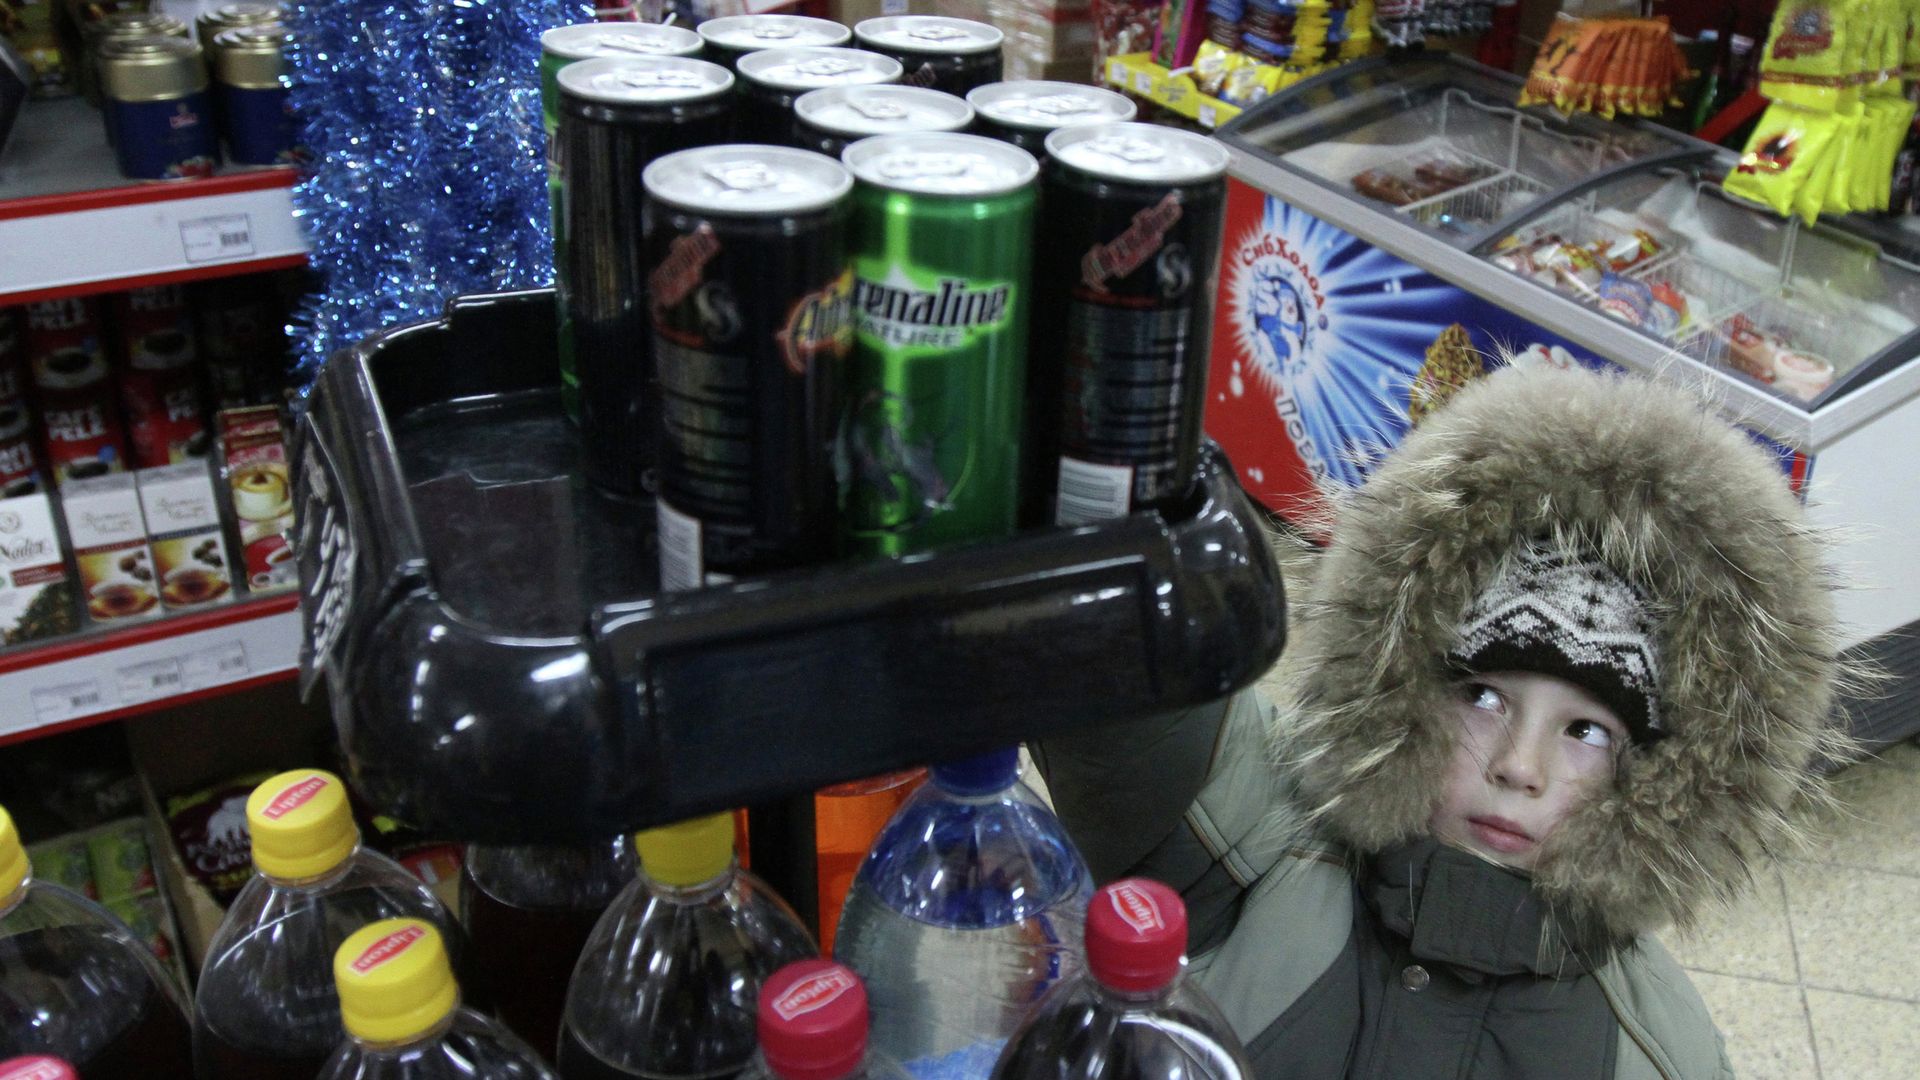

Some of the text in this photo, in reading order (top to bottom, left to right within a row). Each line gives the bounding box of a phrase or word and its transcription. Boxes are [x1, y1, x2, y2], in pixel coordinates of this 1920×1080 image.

[267, 781, 321, 816] Lipton
[1119, 888, 1156, 929] Lipton
[357, 928, 419, 968] Lipton
[783, 974, 846, 1011] Lipton
